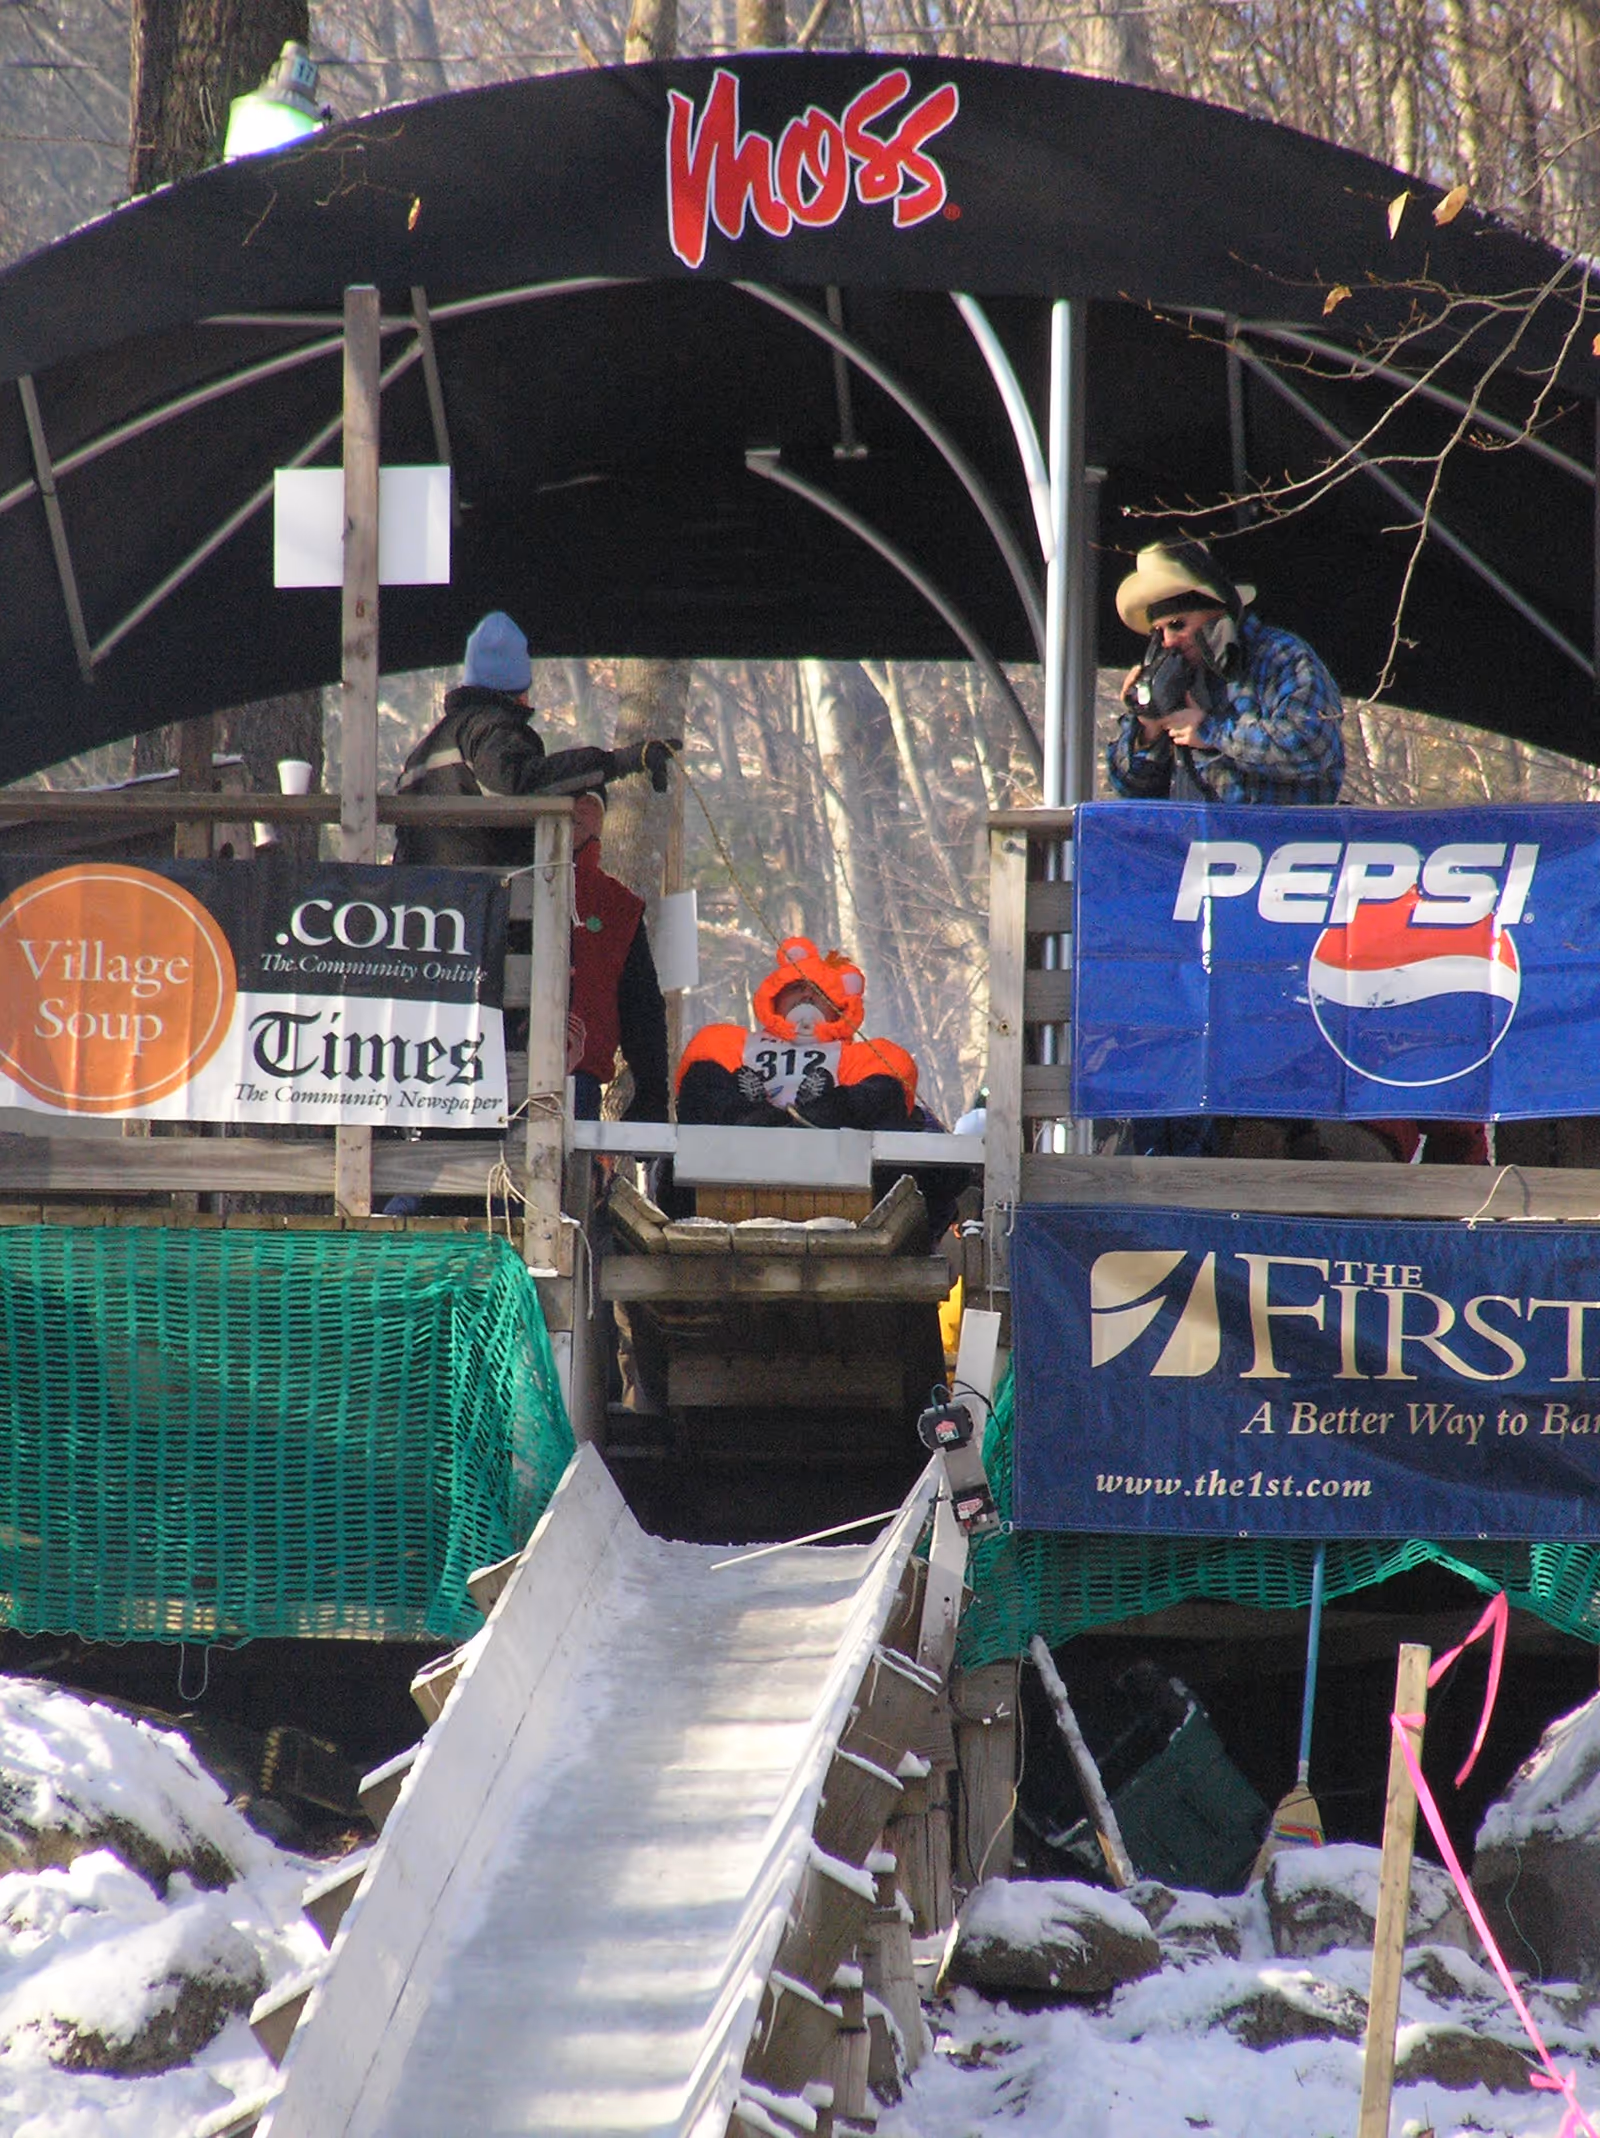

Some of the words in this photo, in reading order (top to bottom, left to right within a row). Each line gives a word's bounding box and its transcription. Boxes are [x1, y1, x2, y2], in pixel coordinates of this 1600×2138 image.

[1172, 841, 1540, 924] PEPSI
[275, 899, 471, 956] .com
[17, 939, 190, 998] Village
[260, 953, 293, 973] The
[298, 954, 419, 980] Community
[422, 960, 489, 983] Online
[34, 998, 163, 1057] Soup
[248, 1010, 486, 1087] Times
[756, 1048, 827, 1081] 312
[234, 1083, 269, 1102] The
[274, 1084, 392, 1111] Community
[398, 1090, 503, 1115] Newspaper
[1333, 1260, 1424, 1289] THE
[1234, 1252, 1600, 1382] FIRST
[1240, 1401, 1275, 1434] A
[1287, 1401, 1394, 1435] Better
[1406, 1403, 1486, 1445] Way
[1496, 1409, 1529, 1436] to
[1096, 1469, 1373, 1497] www.the1st.com
